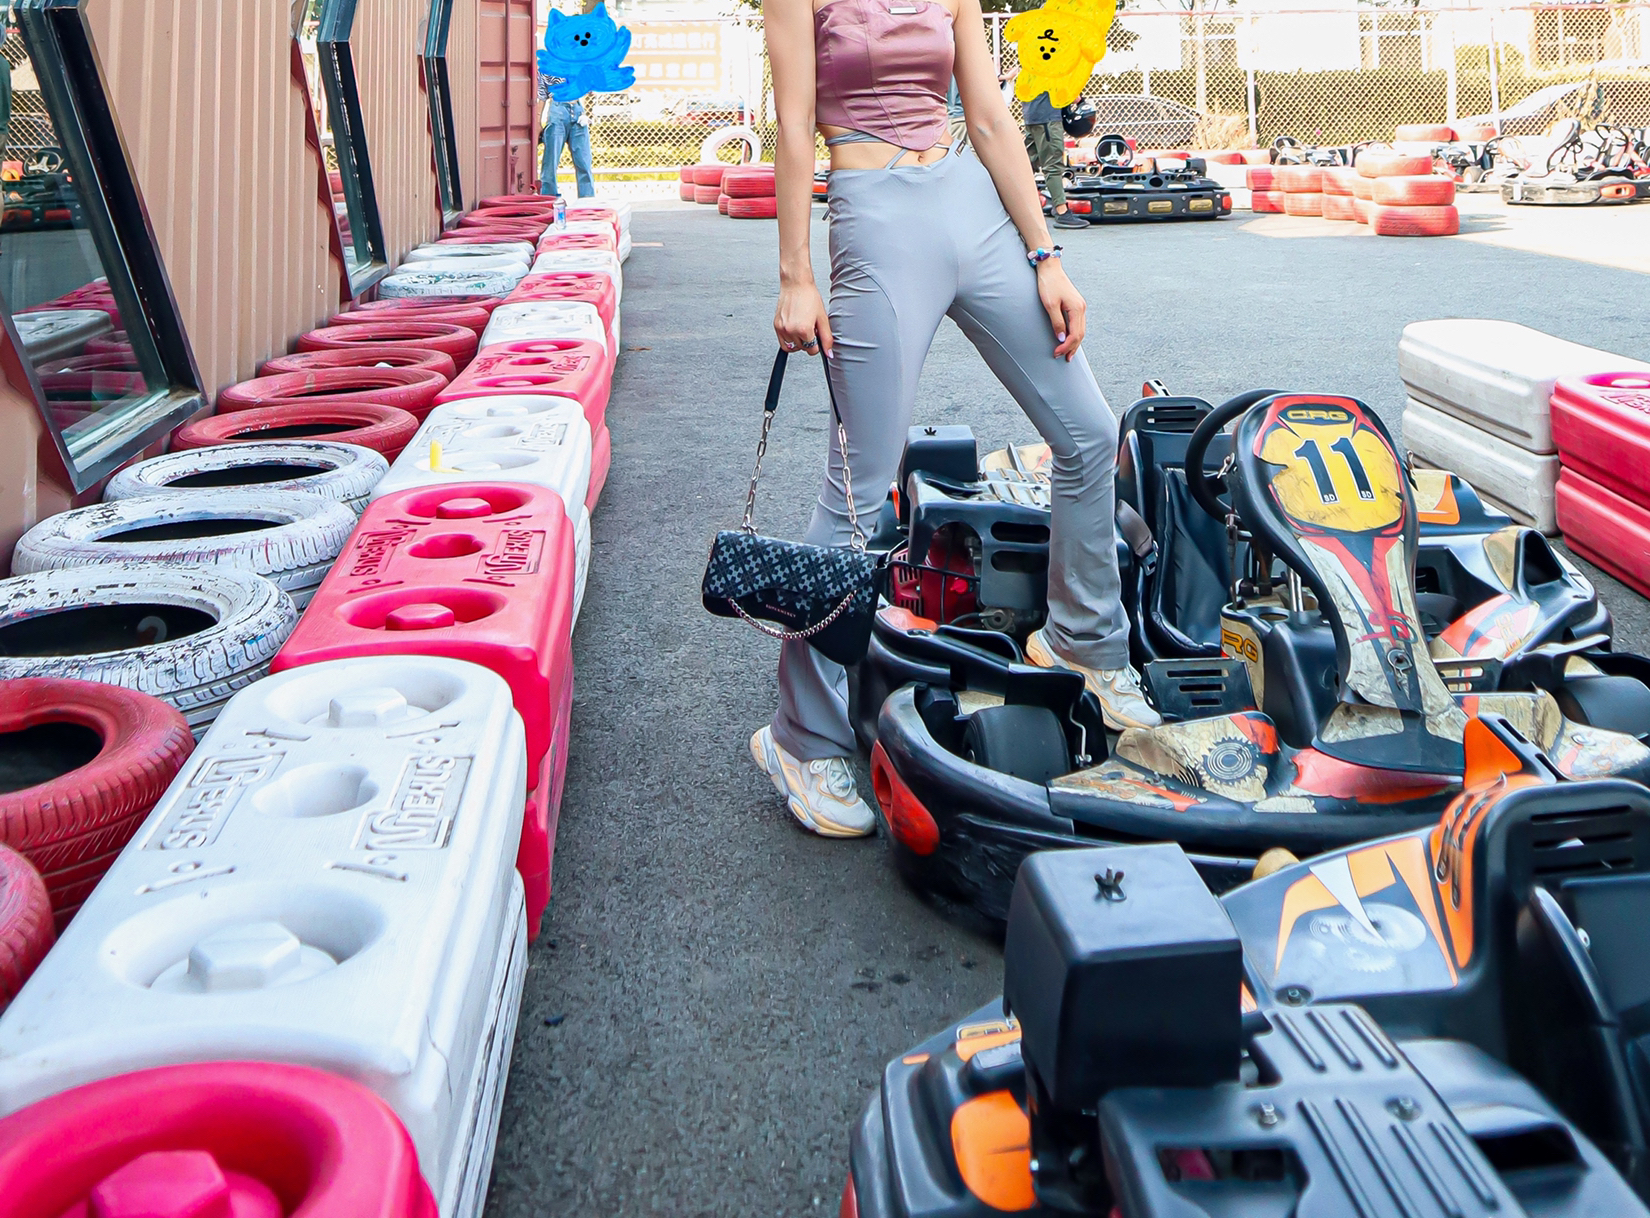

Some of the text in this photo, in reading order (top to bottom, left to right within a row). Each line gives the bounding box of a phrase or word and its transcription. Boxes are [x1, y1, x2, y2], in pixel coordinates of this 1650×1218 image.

[1286, 408, 1349, 421] CRG
[1293, 436, 1376, 504] 11
[1221, 628, 1259, 663] RG
